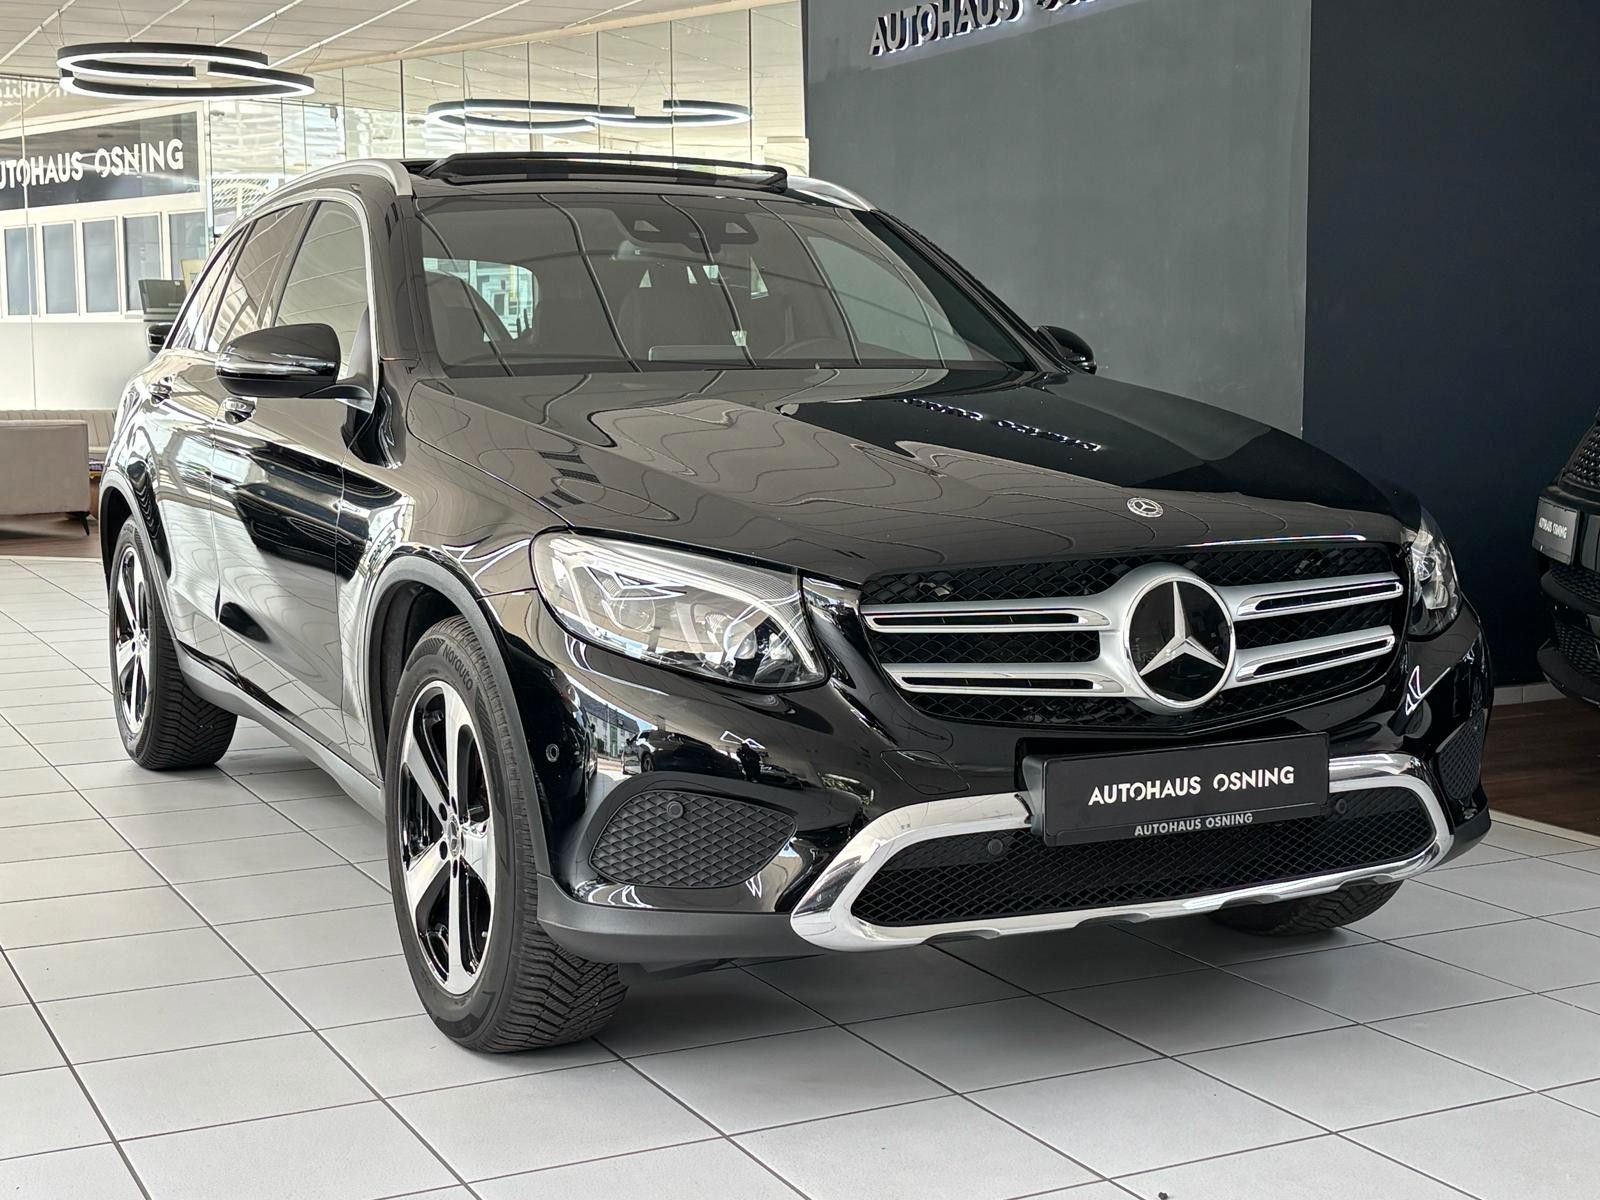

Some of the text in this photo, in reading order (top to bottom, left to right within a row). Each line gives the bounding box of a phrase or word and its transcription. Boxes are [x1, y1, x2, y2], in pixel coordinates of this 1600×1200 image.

[95, 138, 184, 177] OSNING
[443, 644, 473, 690] Norauto
[1088, 766, 1294, 806] AUTOHAUS OSNING
[1134, 812, 1253, 836] AUTOHAUS OSNING
